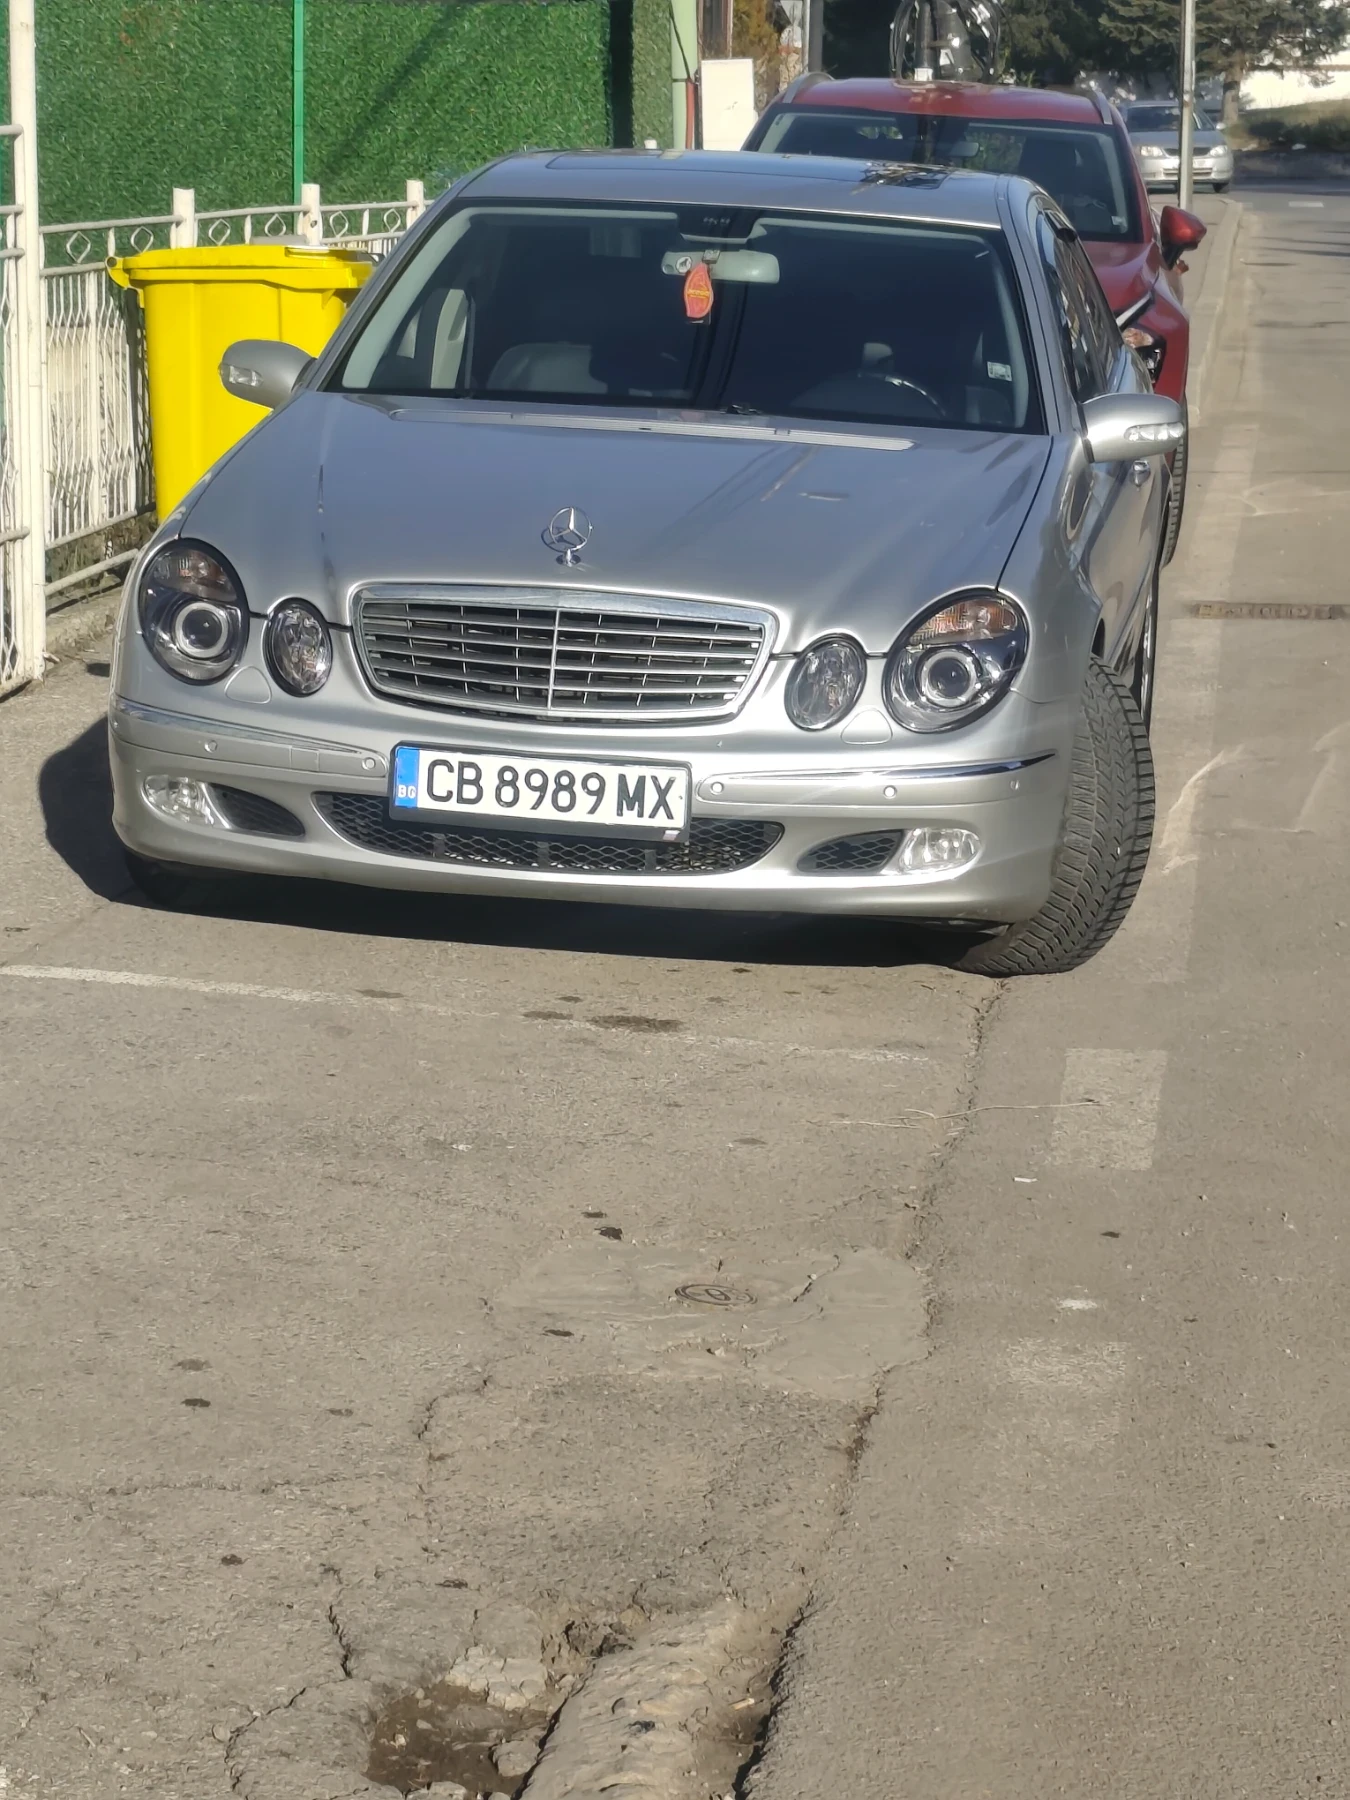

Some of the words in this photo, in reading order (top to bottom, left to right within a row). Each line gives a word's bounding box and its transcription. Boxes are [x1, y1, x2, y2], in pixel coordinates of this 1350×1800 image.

[397, 784, 417, 799] BG
[426, 758, 483, 805] CB
[494, 765, 606, 814] 8989
[615, 773, 676, 820] MX
